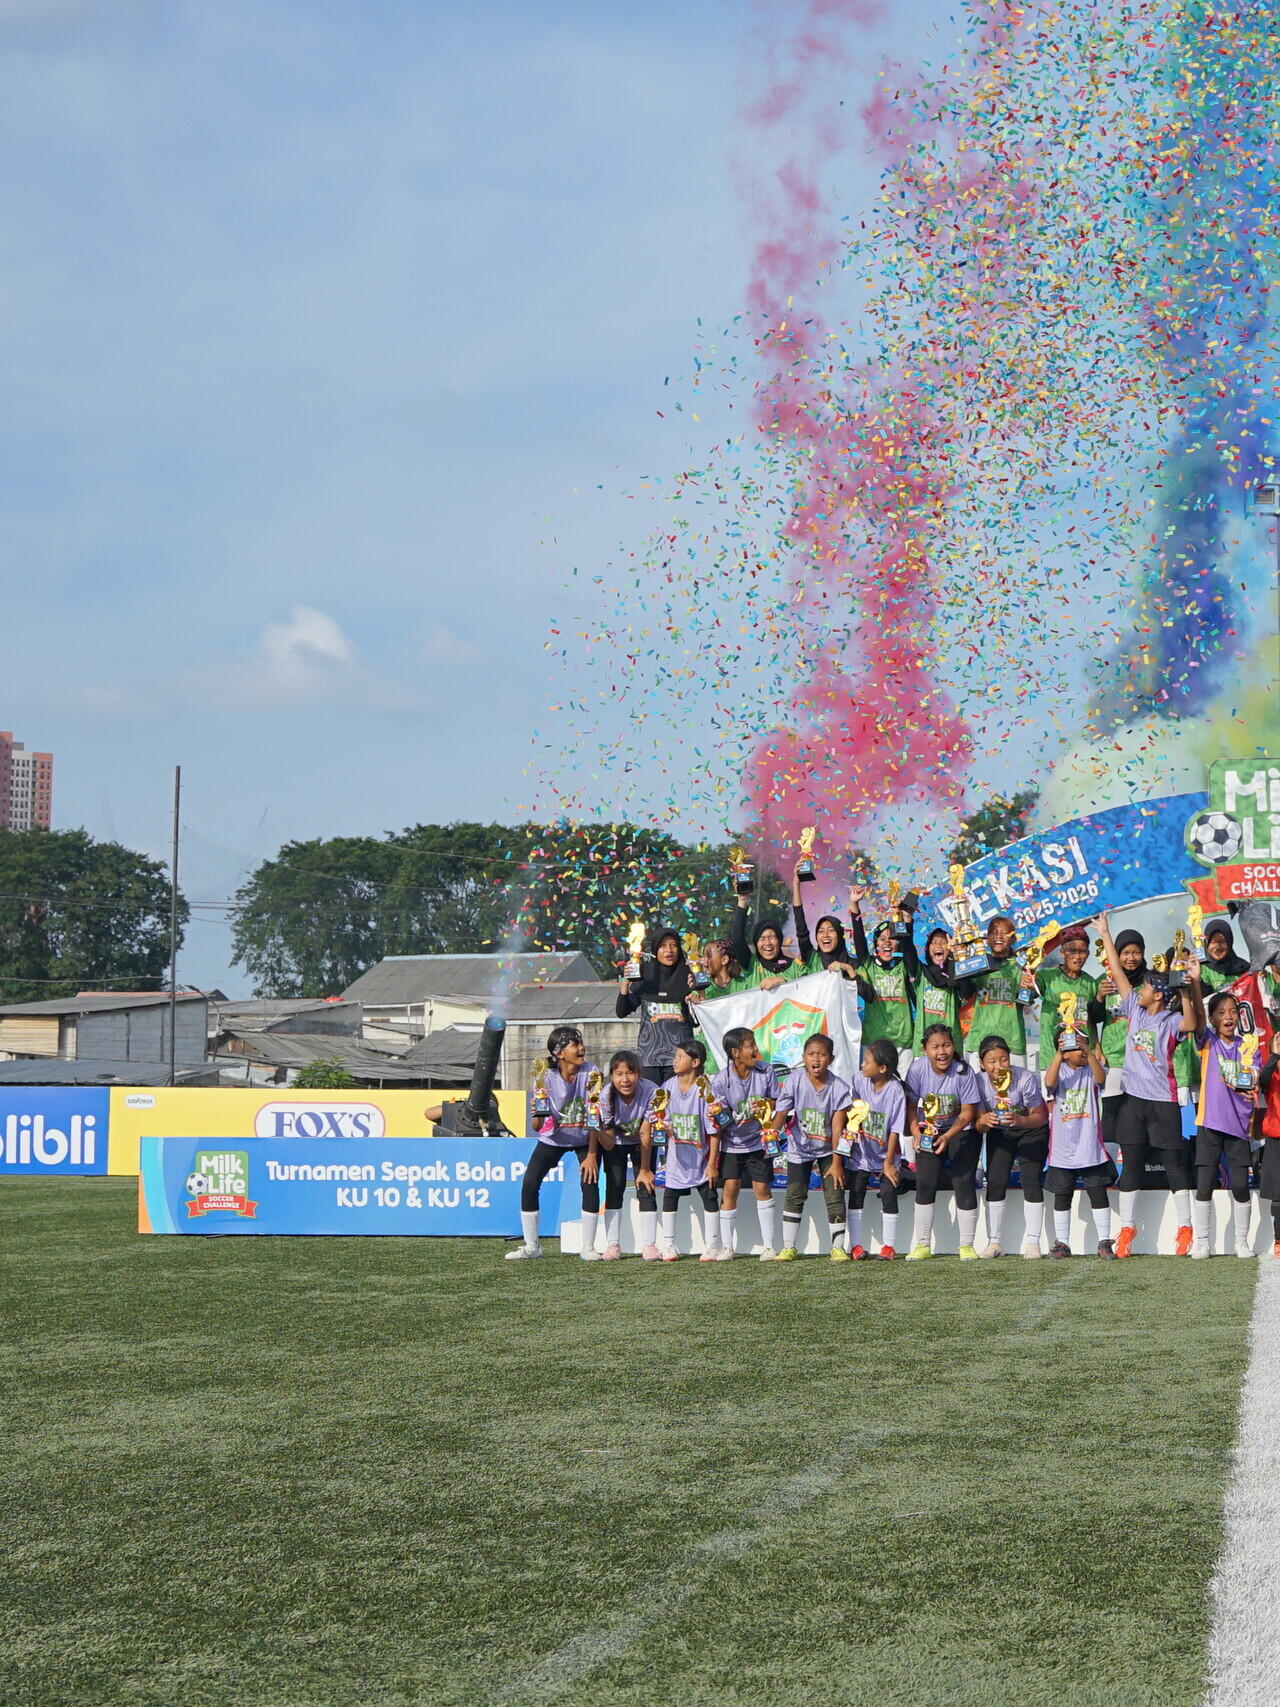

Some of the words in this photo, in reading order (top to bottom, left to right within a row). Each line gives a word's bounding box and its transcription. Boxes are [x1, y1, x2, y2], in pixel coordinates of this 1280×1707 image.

[1013, 880, 1099, 929] 2025-2026
[271, 1111, 373, 1137] FOX'S
[0, 1115, 96, 1165] libli
[200, 1153, 244, 1174] Milk
[266, 1161, 375, 1181] Turnamen
[381, 1160, 449, 1186] Sepak
[455, 1160, 505, 1181] Bola
[511, 1160, 564, 1181] Pri
[207, 1174, 246, 1194] Life
[202, 1201, 241, 1209] CHALLENGE
[336, 1188, 367, 1208] KU
[373, 1188, 400, 1207] 10
[406, 1188, 422, 1208] &
[428, 1188, 459, 1208] KU
[465, 1188, 490, 1207] 12
